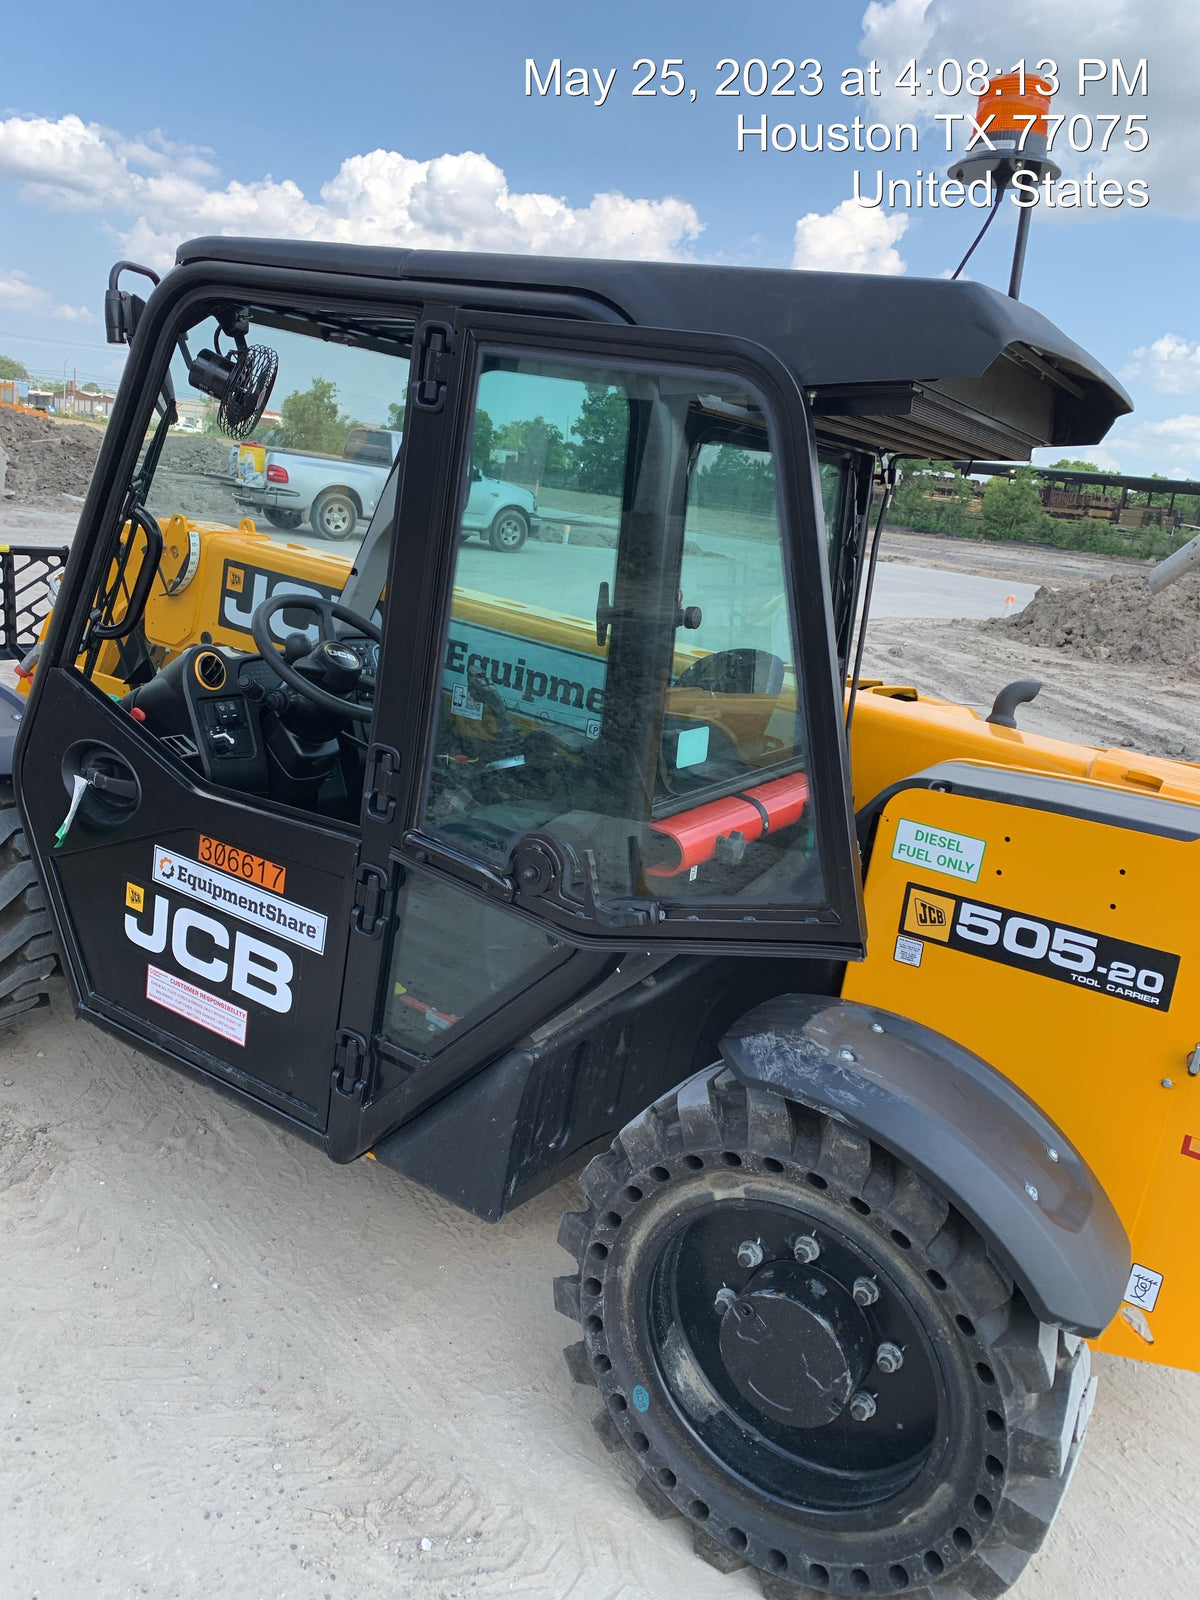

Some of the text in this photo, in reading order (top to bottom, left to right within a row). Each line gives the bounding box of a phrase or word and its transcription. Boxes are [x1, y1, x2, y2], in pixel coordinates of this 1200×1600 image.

[224, 573, 340, 643] JC
[897, 843, 975, 874] FUEL ONLY
[914, 829, 964, 854] DIESEL
[200, 837, 285, 889] 306617
[177, 865, 317, 939] EquipmentShare
[918, 902, 945, 926] JCB
[124, 894, 294, 1014] JCB
[170, 978, 200, 996] CUSTOMER
[200, 992, 246, 1019] RESPONSIBILITY
[1071, 973, 1160, 1005] TOOL CARRIER
